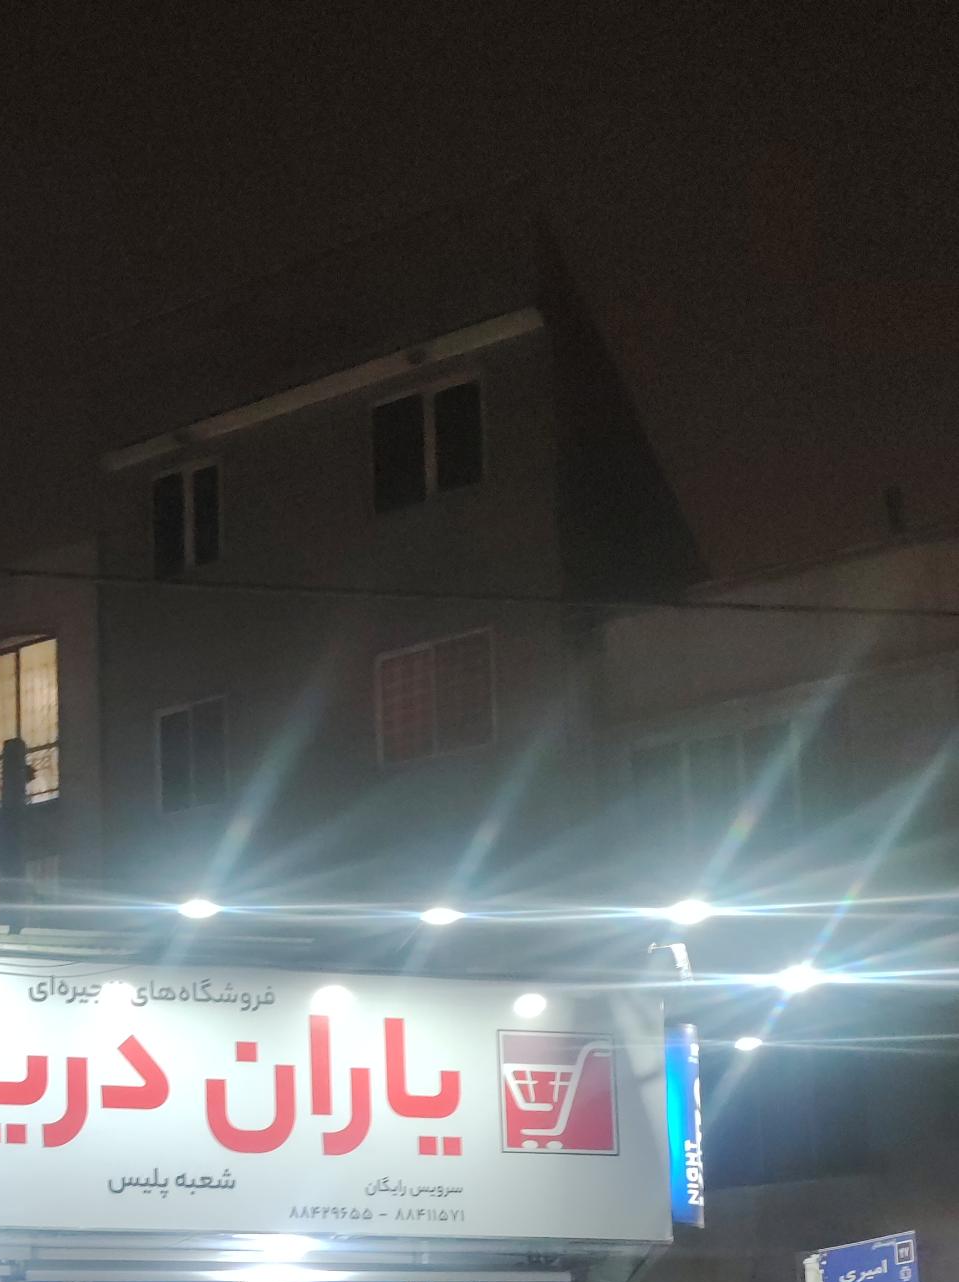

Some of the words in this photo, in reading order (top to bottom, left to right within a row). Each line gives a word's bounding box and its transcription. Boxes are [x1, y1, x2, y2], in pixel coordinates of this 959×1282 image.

[205, 1014, 462, 1156] یاران
[107, 1167, 169, 1199] پلیس
[175, 1168, 237, 1195] شعبه
[364, 1176, 407, 1196] رایگان
[684, 1140, 699, 1206] NIGHT
[409, 1183, 464, 1198] سرویس
